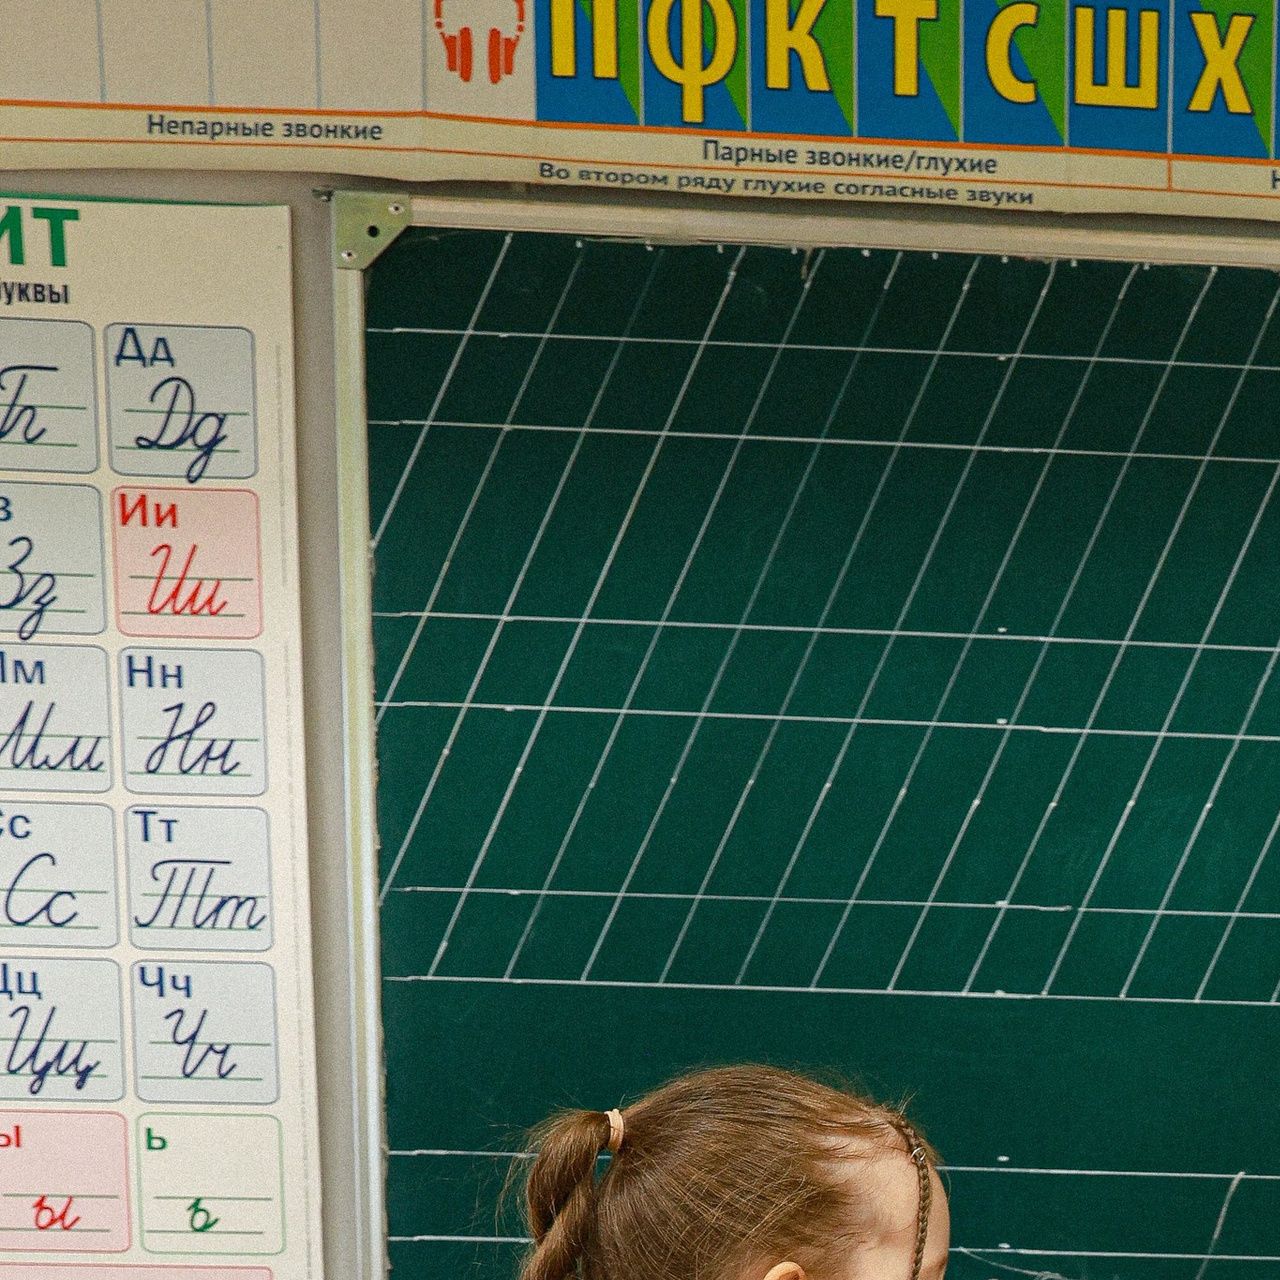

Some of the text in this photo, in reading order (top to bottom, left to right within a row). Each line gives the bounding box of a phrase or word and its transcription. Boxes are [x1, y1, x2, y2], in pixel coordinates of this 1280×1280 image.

[766, 0, 831, 91] К
[875, 0, 938, 96] Т
[985, 2, 1039, 104] С
[1074, 6, 1159, 109] Ш
[1188, 12, 1254, 114] Х
[147, 114, 383, 141] Непарные звонкие
[703, 138, 998, 177] Парные звонкие/глухие
[539, 162, 1034, 206] Во втором ряду глухие согласные звуки
[0, 282, 70, 305] уквы
[115, 327, 175, 368] Дд
[135, 376, 228, 483] Дд
[117, 491, 179, 529] Ии
[147, 542, 228, 616] Ии
[126, 654, 183, 689] Нн
[145, 701, 240, 775] Нн
[132, 809, 179, 843] Тт
[5, 852, 78, 927] Сс
[134, 859, 266, 930] Тт
[139, 965, 192, 999] Чч
[7, 1005, 100, 1095] Цц
[164, 1008, 237, 1080] Чч
